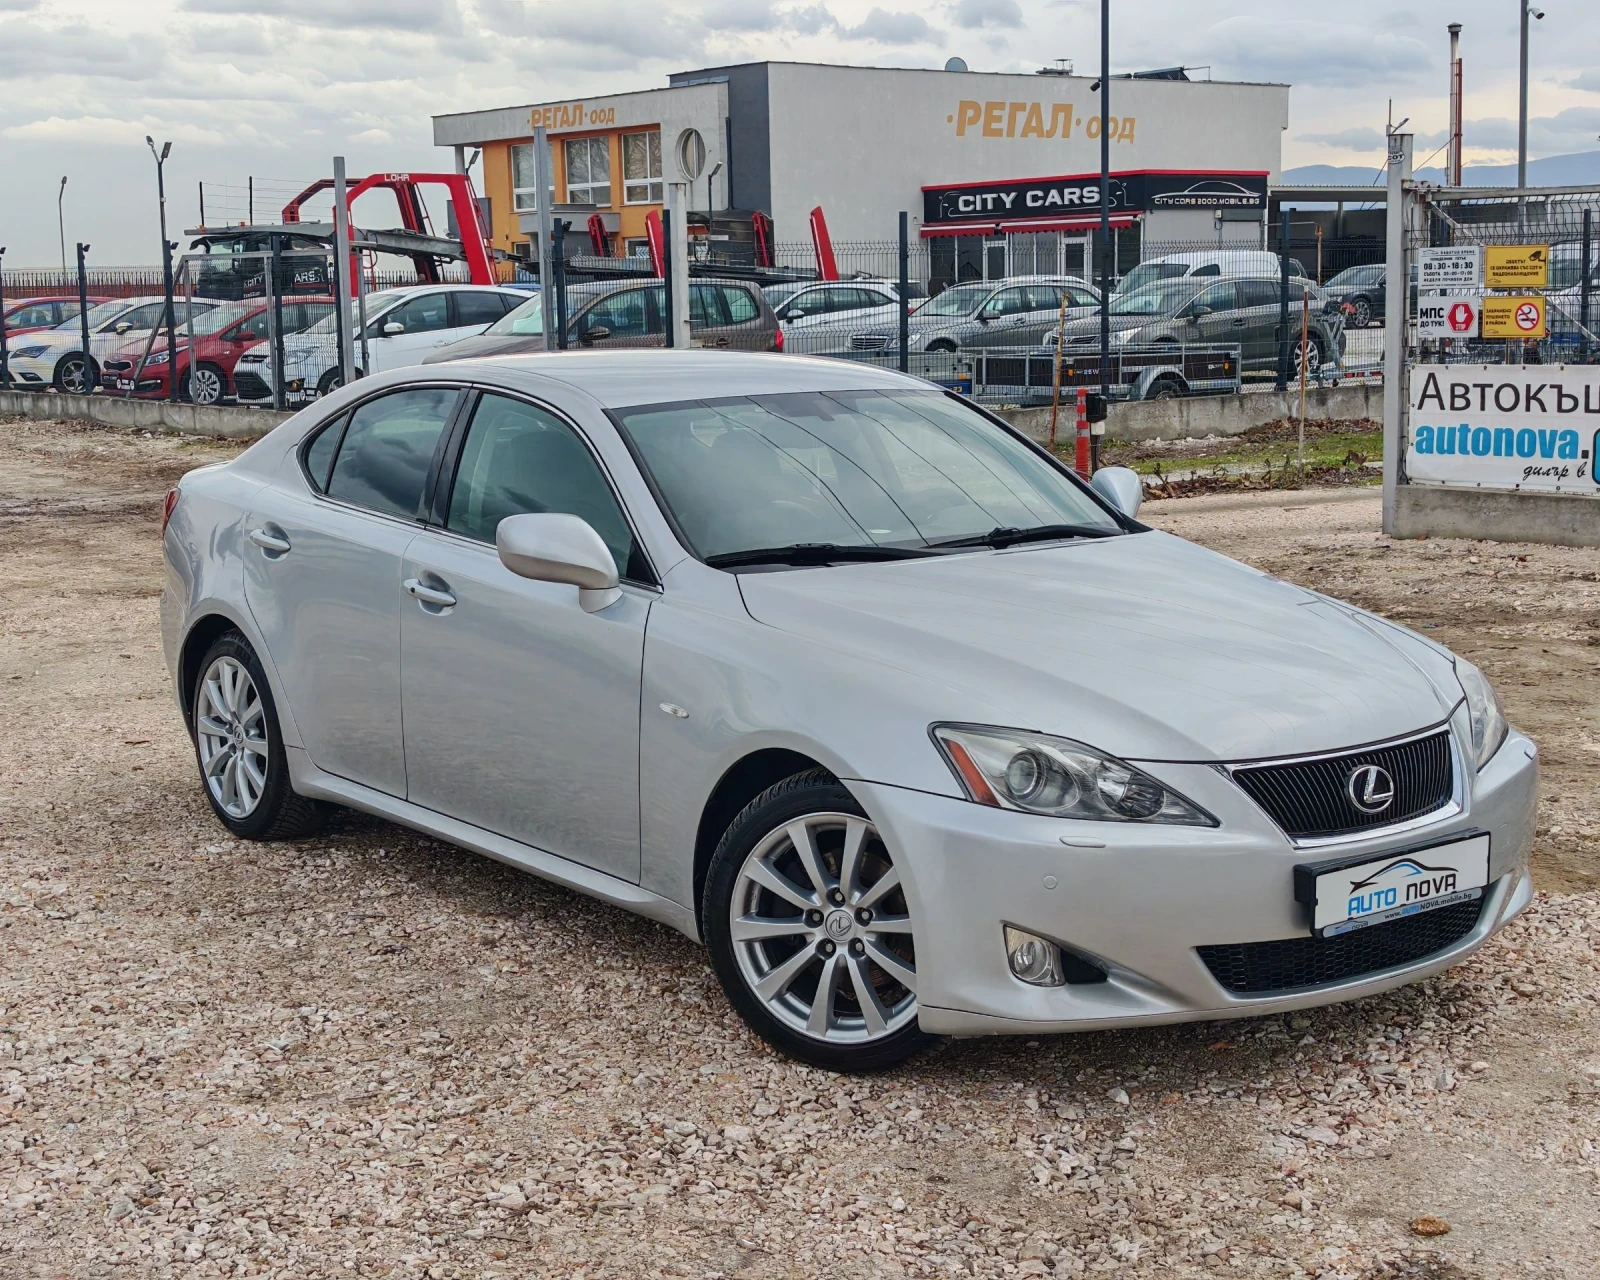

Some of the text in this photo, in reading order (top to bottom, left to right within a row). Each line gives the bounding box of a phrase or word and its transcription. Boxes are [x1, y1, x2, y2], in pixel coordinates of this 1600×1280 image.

[384, 173, 410, 182] LOHR
[958, 186, 1100, 212] CITY CARS
[1420, 307, 1445, 319] МПС
[1348, 873, 1457, 916] AUTO NOVA
